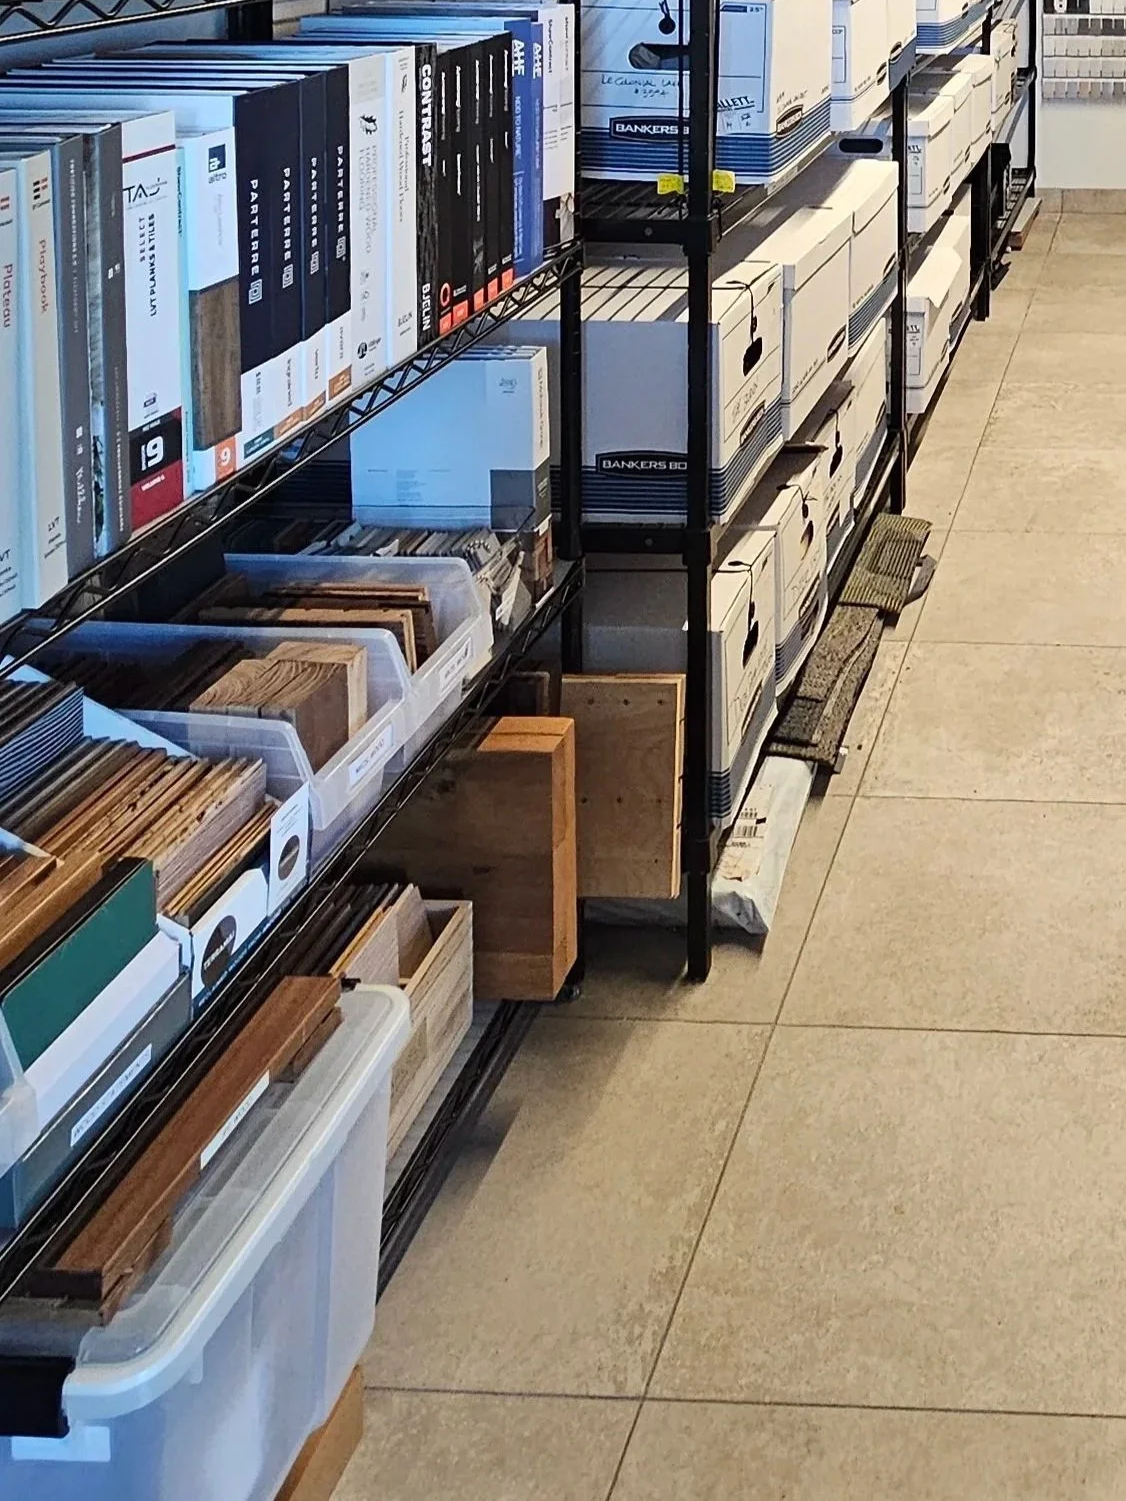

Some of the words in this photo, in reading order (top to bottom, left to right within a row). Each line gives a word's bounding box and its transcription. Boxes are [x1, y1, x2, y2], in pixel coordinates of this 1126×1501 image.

[511, 38, 525, 78] AHF
[532, 42, 542, 79] AHF
[422, 63, 432, 167] CONTRAST
[616, 123, 679, 134] BANKERS
[123, 178, 161, 203] TAJ
[208, 172, 227, 184] altro
[250, 179, 259, 276] PARTERRE
[283, 167, 291, 261] PARTERRE
[3, 263, 13, 328] Plateau
[39, 239, 48, 313] Playbook
[422, 282, 431, 331] BJELIN
[221, 447, 230, 466] 9
[602, 459, 667, 469] BANKERS
[669, 461, 687, 470] BO
